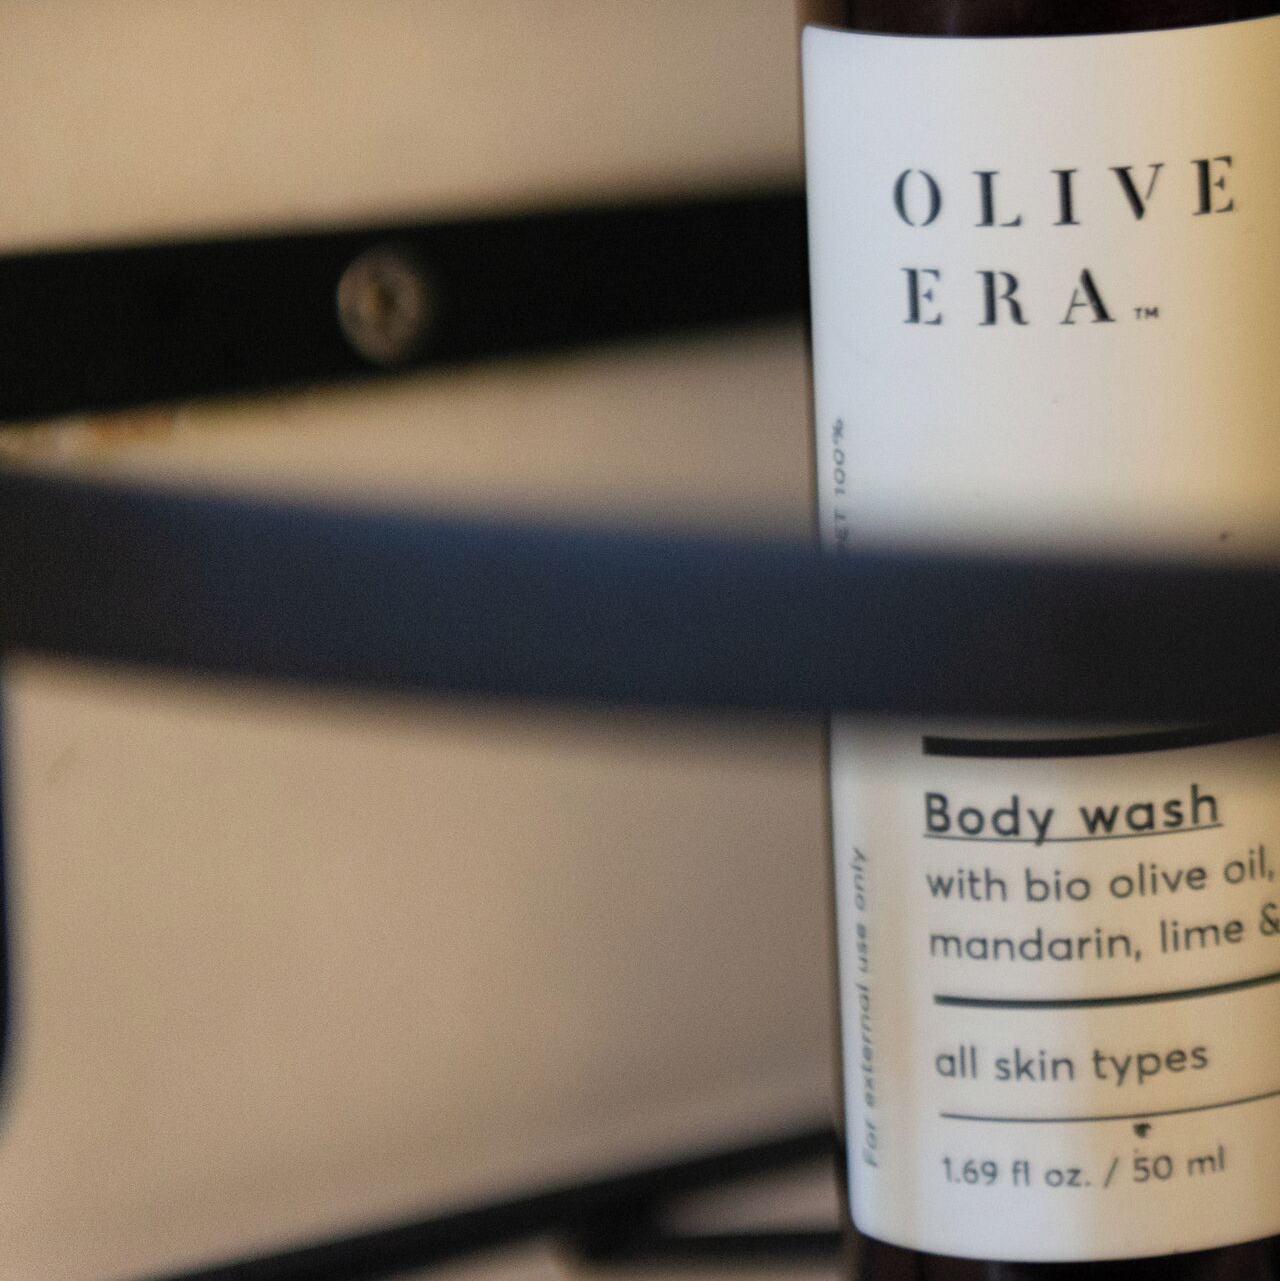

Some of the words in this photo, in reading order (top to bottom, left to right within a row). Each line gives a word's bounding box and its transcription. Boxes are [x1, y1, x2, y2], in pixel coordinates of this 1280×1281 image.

[892, 155, 1235, 228] OLIVE
[832, 417, 846, 496] 100%
[925, 792, 1054, 845] Body
[1079, 784, 1218, 835] wash
[850, 847, 867, 913] only
[927, 865, 1007, 902] with
[1027, 868, 1091, 901] bio
[1110, 864, 1206, 898] olive
[1224, 845, 1275, 882] oil,
[856, 922, 869, 975] use
[930, 926, 1142, 962] mandarin,
[1160, 920, 1244, 953] lime
[856, 981, 876, 1110] external
[936, 1046, 976, 1078] all
[995, 1049, 1074, 1082] skin
[1094, 1045, 1208, 1085] types
[863, 1118, 878, 1168] For
[942, 1158, 998, 1184] 1.69
[1014, 1159, 1029, 1187] fl
[1045, 1167, 1091, 1188] oz.
[1104, 1159, 1118, 1188] /
[1133, 1155, 1172, 1181] 50
[1188, 1146, 1224, 1177] ml
